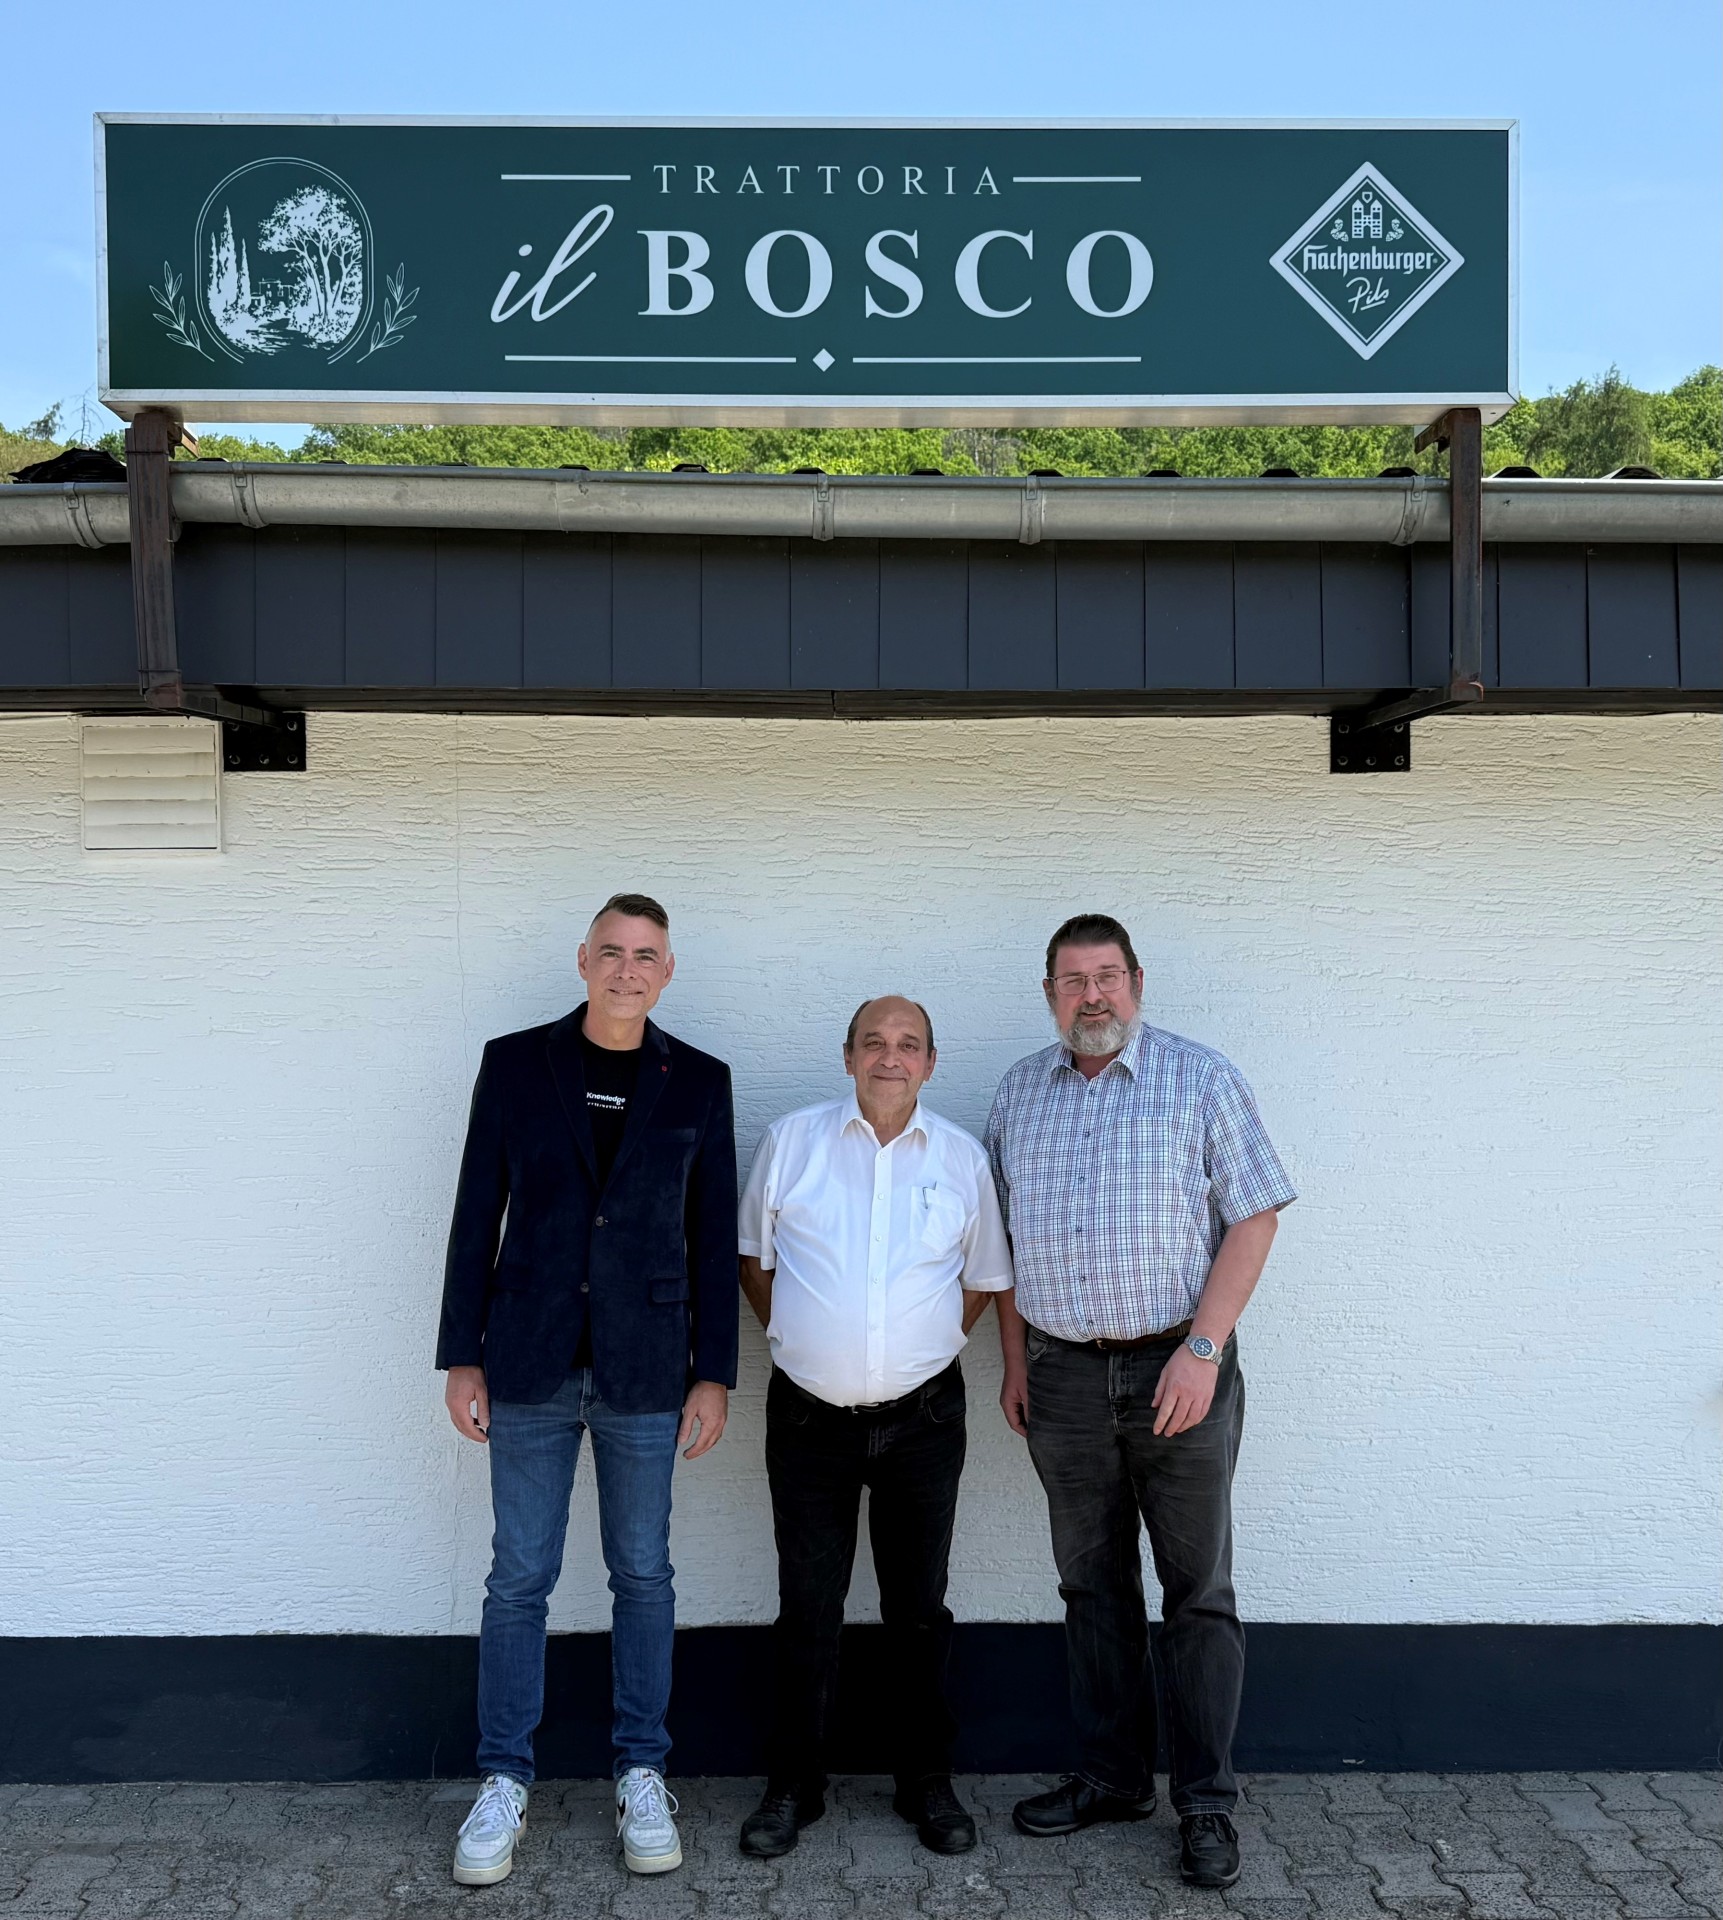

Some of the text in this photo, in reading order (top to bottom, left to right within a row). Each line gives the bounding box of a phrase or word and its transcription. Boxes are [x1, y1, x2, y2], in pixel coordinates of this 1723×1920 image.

[653, 165, 1001, 195] TRATTORIA
[490, 204, 1155, 323] il BOSCO
[1303, 244, 1434, 278] Hachenburger
[1346, 276, 1389, 314] Pils
[586, 1092, 626, 1105] Knowledge
